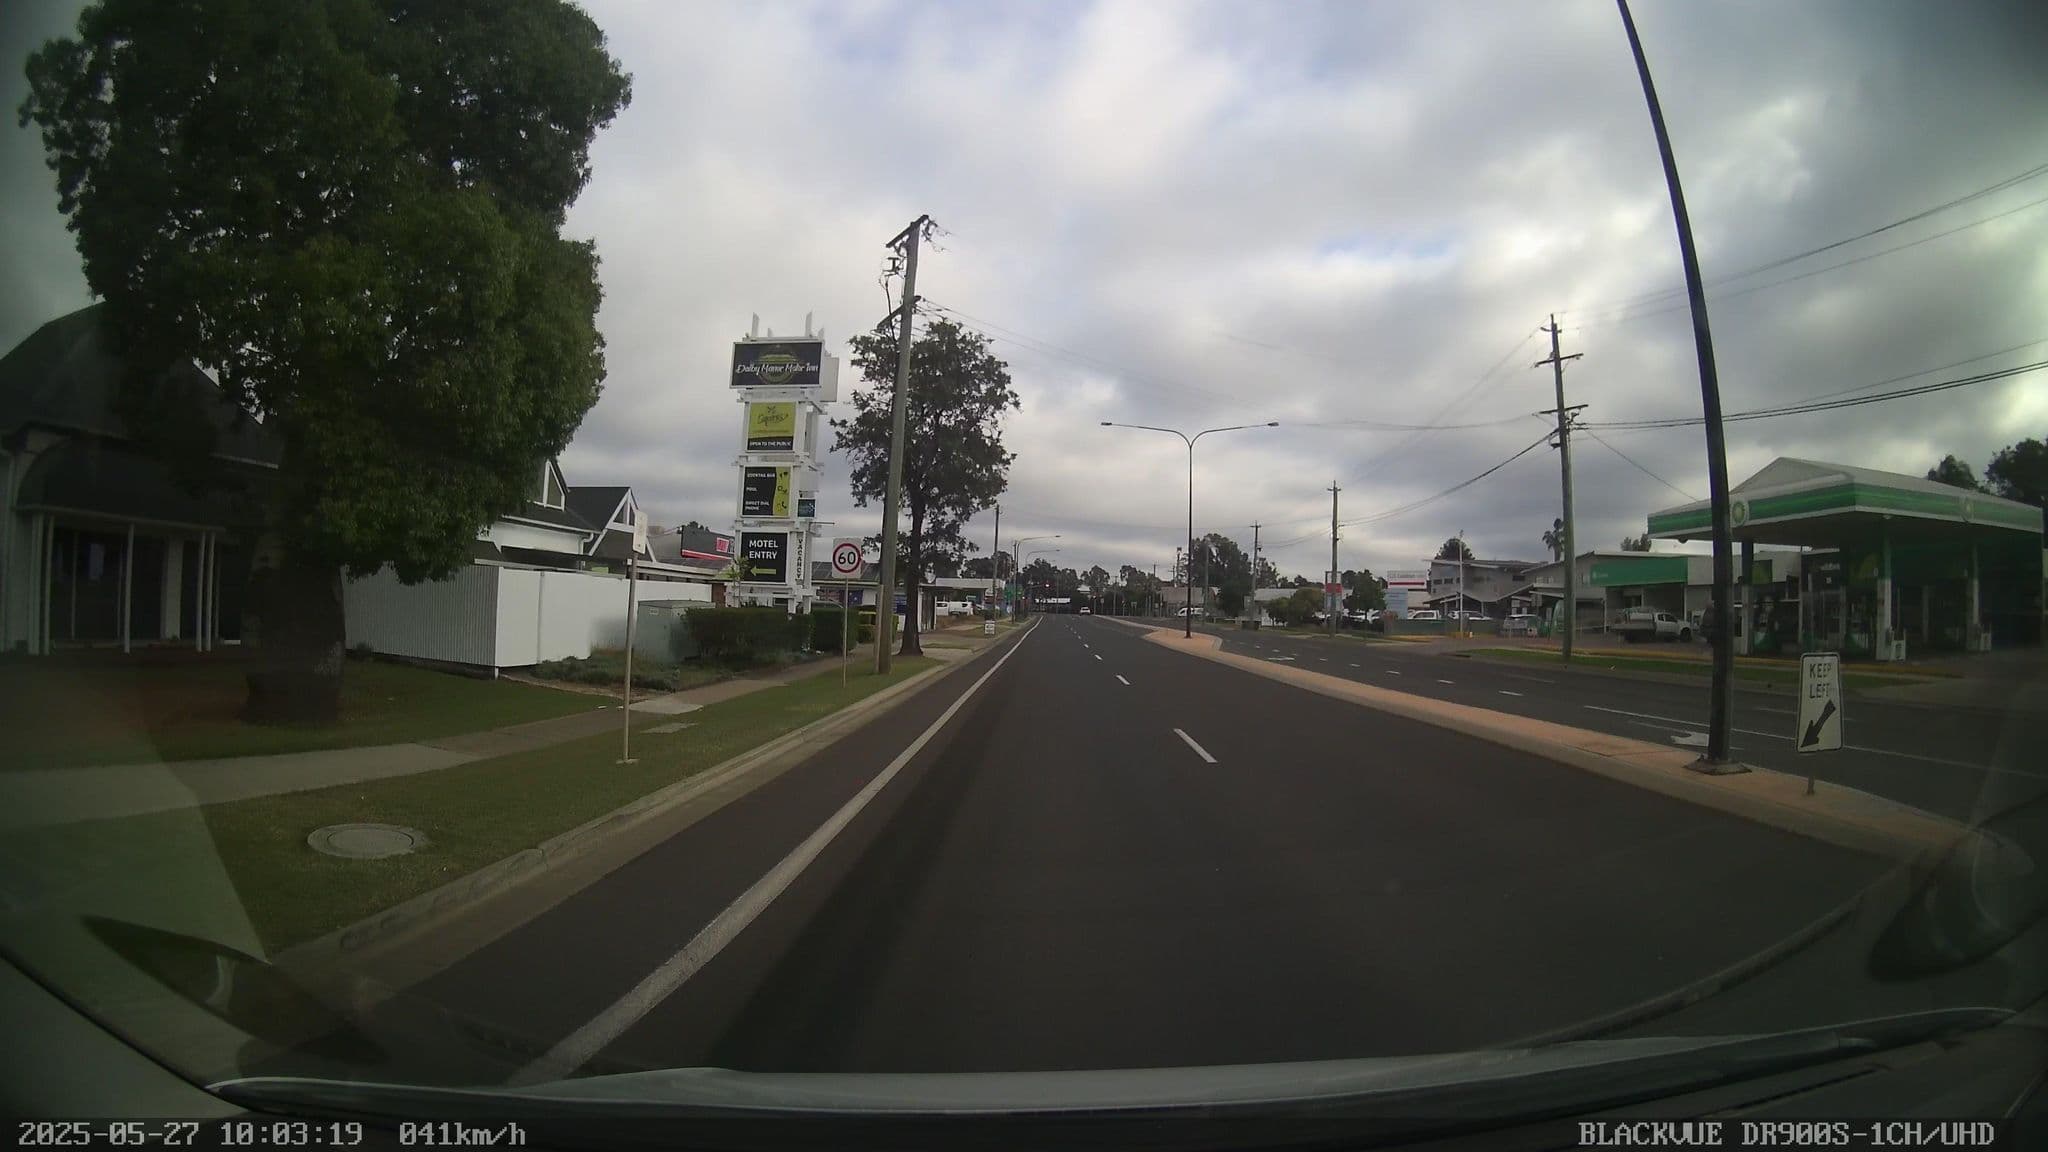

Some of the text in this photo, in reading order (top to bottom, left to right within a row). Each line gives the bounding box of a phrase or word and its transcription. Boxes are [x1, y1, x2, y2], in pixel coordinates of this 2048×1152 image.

[736, 363, 761, 376] Dalby
[806, 362, 819, 373] Inn
[749, 539, 779, 548] MOTEL
[749, 550, 778, 560] ENTRY
[838, 551, 856, 565] 60
[1809, 663, 1832, 679] KEEP
[1809, 683, 1831, 699] LEFT
